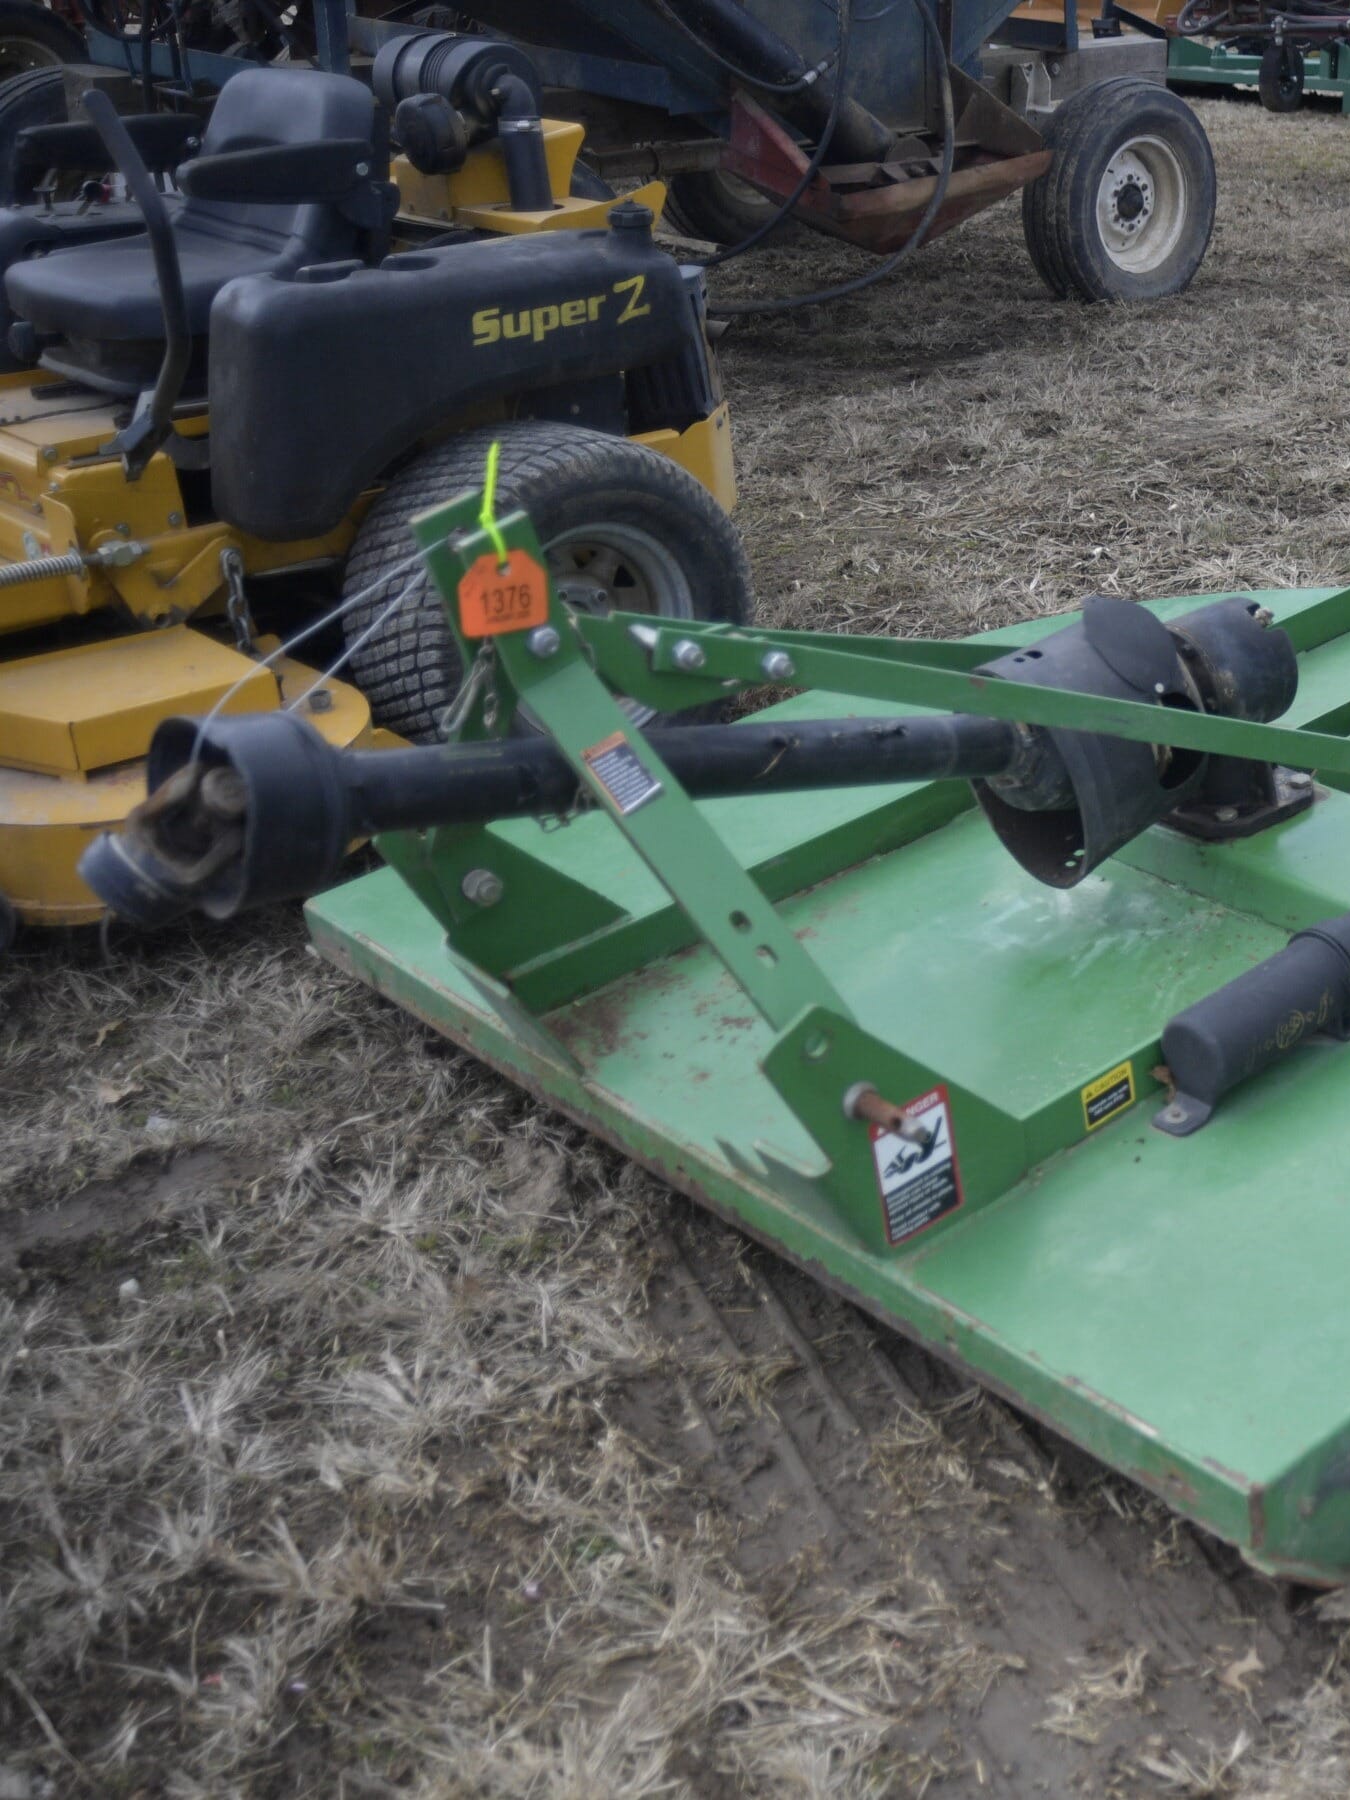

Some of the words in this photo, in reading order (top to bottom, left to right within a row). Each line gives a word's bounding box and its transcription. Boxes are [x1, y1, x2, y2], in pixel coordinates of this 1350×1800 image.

[472, 295, 606, 346] Super
[612, 274, 651, 325] Z
[480, 583, 531, 617] 1376
[904, 1091, 940, 1116] NGER
